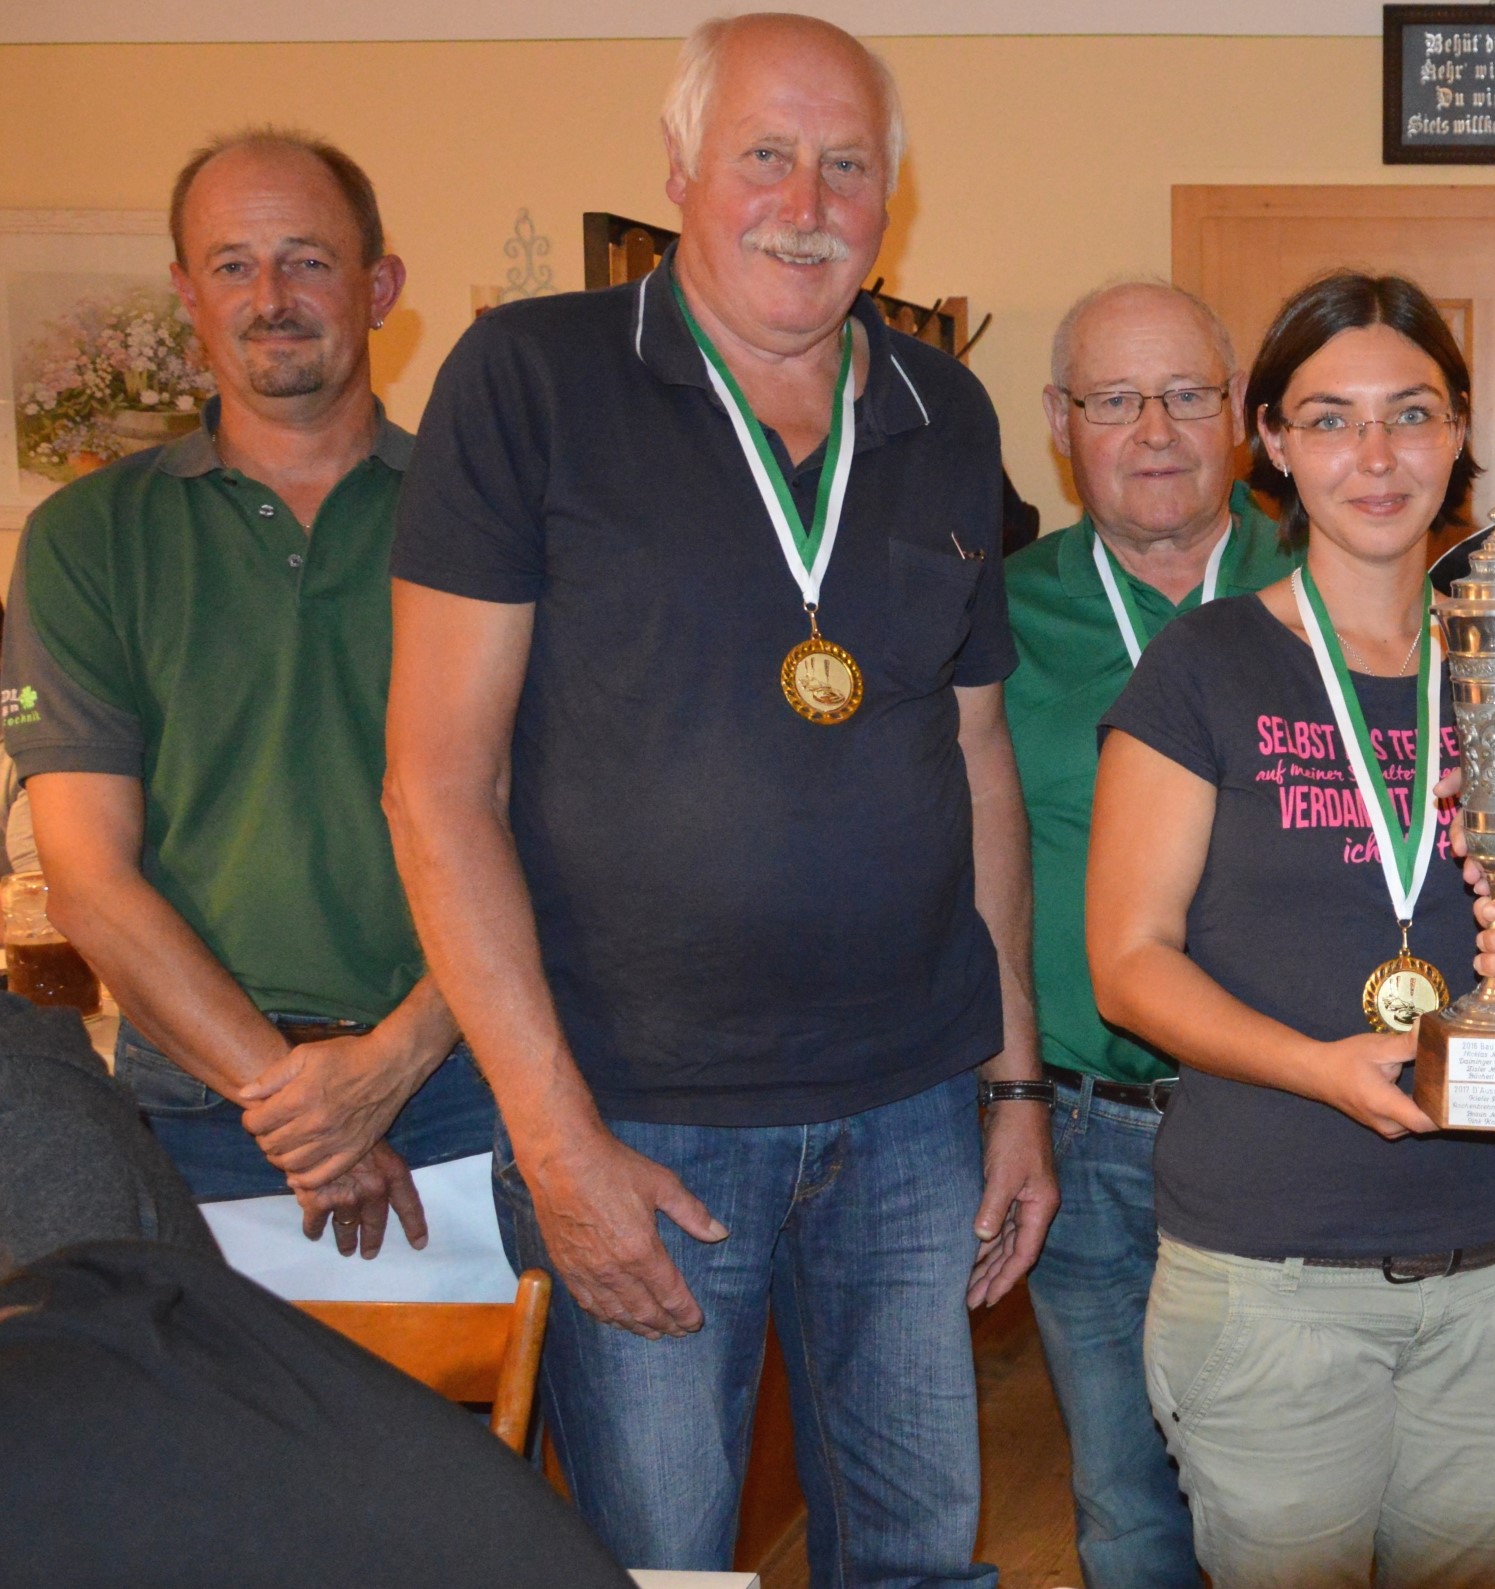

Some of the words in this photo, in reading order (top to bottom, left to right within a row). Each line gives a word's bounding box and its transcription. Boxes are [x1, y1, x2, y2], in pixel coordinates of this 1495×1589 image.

[1436, 86, 1465, 111] Du
[1407, 113, 1450, 138] Stets
[1257, 715, 1337, 760] SELBST
[1255, 759, 1287, 784] auf
[1290, 763, 1345, 783] meiner
[1343, 832, 1382, 864] ich
[1462, 1042, 1478, 1050] 2016
[1454, 1085, 1470, 1093] 2017
